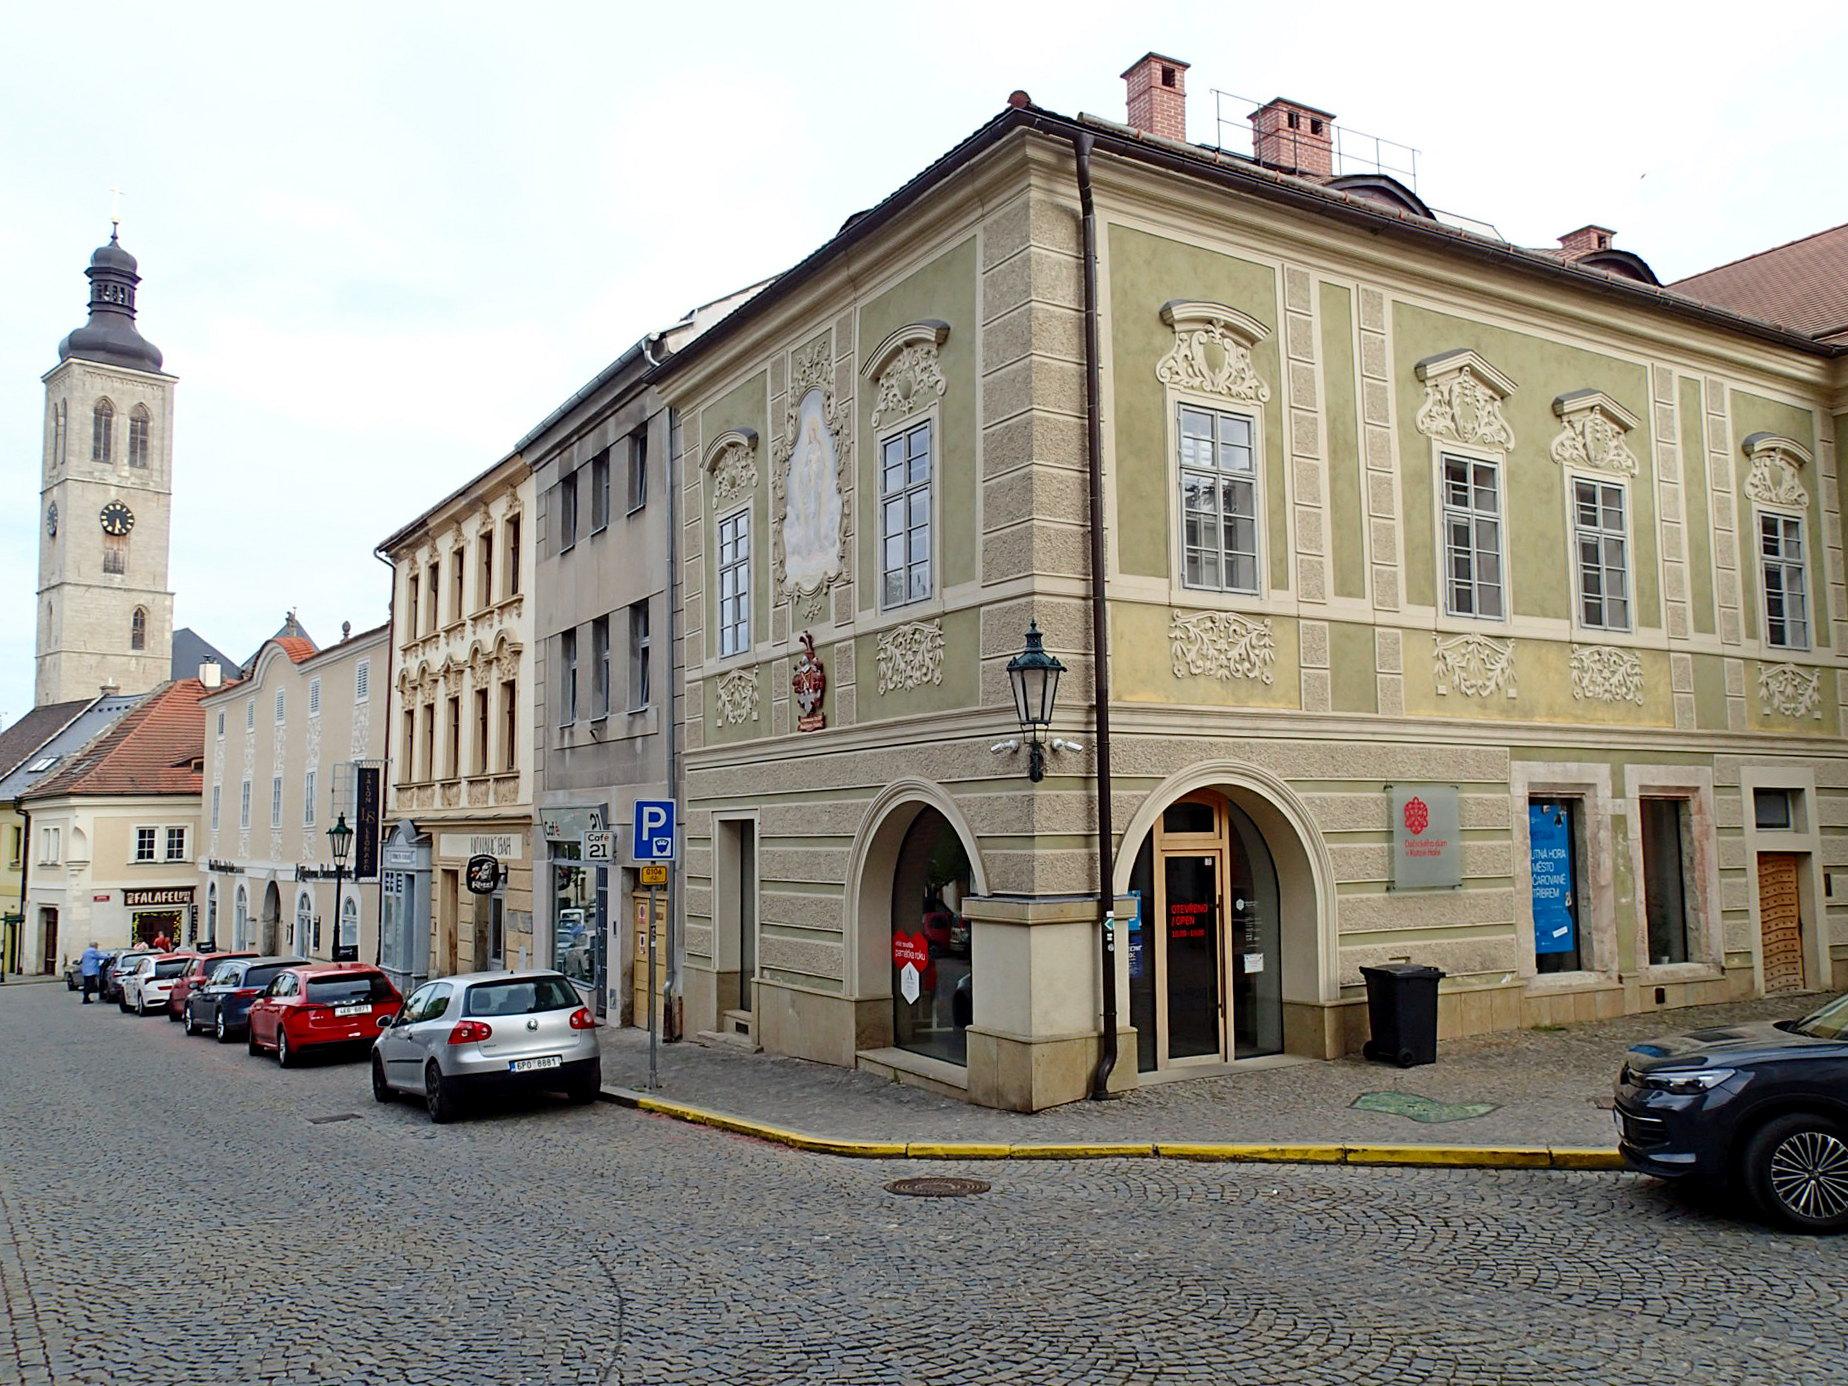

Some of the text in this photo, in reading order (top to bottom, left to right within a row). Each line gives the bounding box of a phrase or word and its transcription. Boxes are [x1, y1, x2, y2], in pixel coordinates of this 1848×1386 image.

[642, 806, 667, 841] P
[588, 833, 610, 842] Café
[589, 844, 608, 858] 21
[1531, 848, 1567, 859] UTNÁ HORA
[1531, 873, 1567, 885] ČAROVANÉ
[134, 891, 179, 904] FALAFEL
